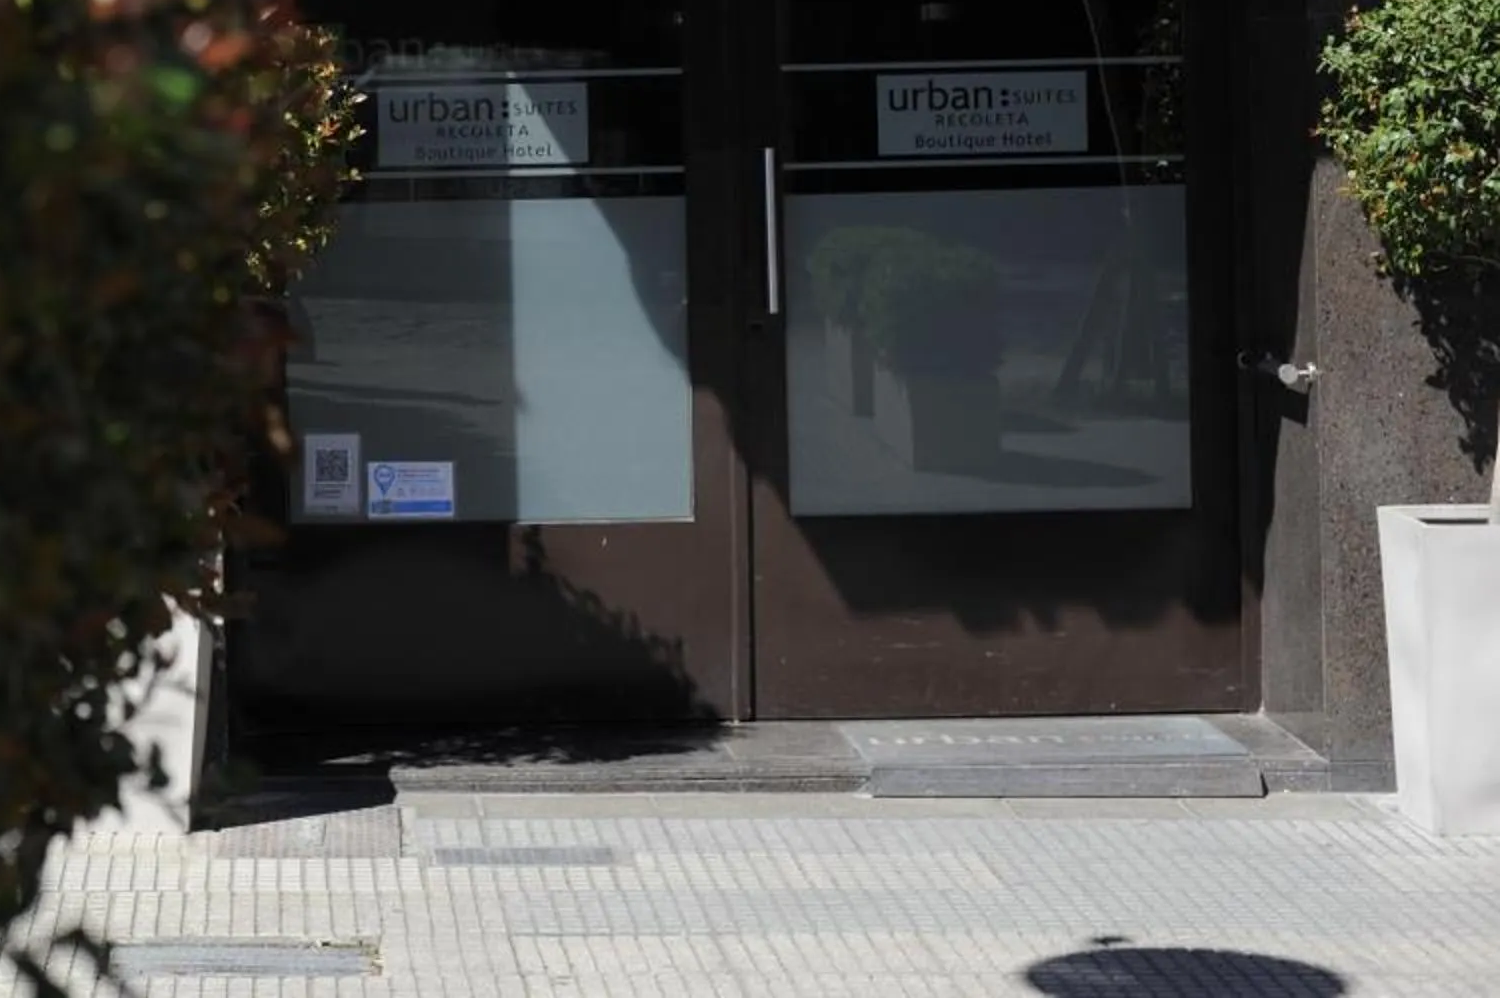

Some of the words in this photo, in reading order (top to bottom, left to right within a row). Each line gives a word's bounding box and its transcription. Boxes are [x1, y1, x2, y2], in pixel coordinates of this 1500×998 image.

[934, 111, 1030, 128] RECOLETA
[436, 124, 529, 139] RECOLETA
[914, 134, 996, 151] Boutique
[1001, 132, 1053, 147] Hotel
[414, 144, 498, 161] Boutique
[503, 143, 552, 158] Hotel
